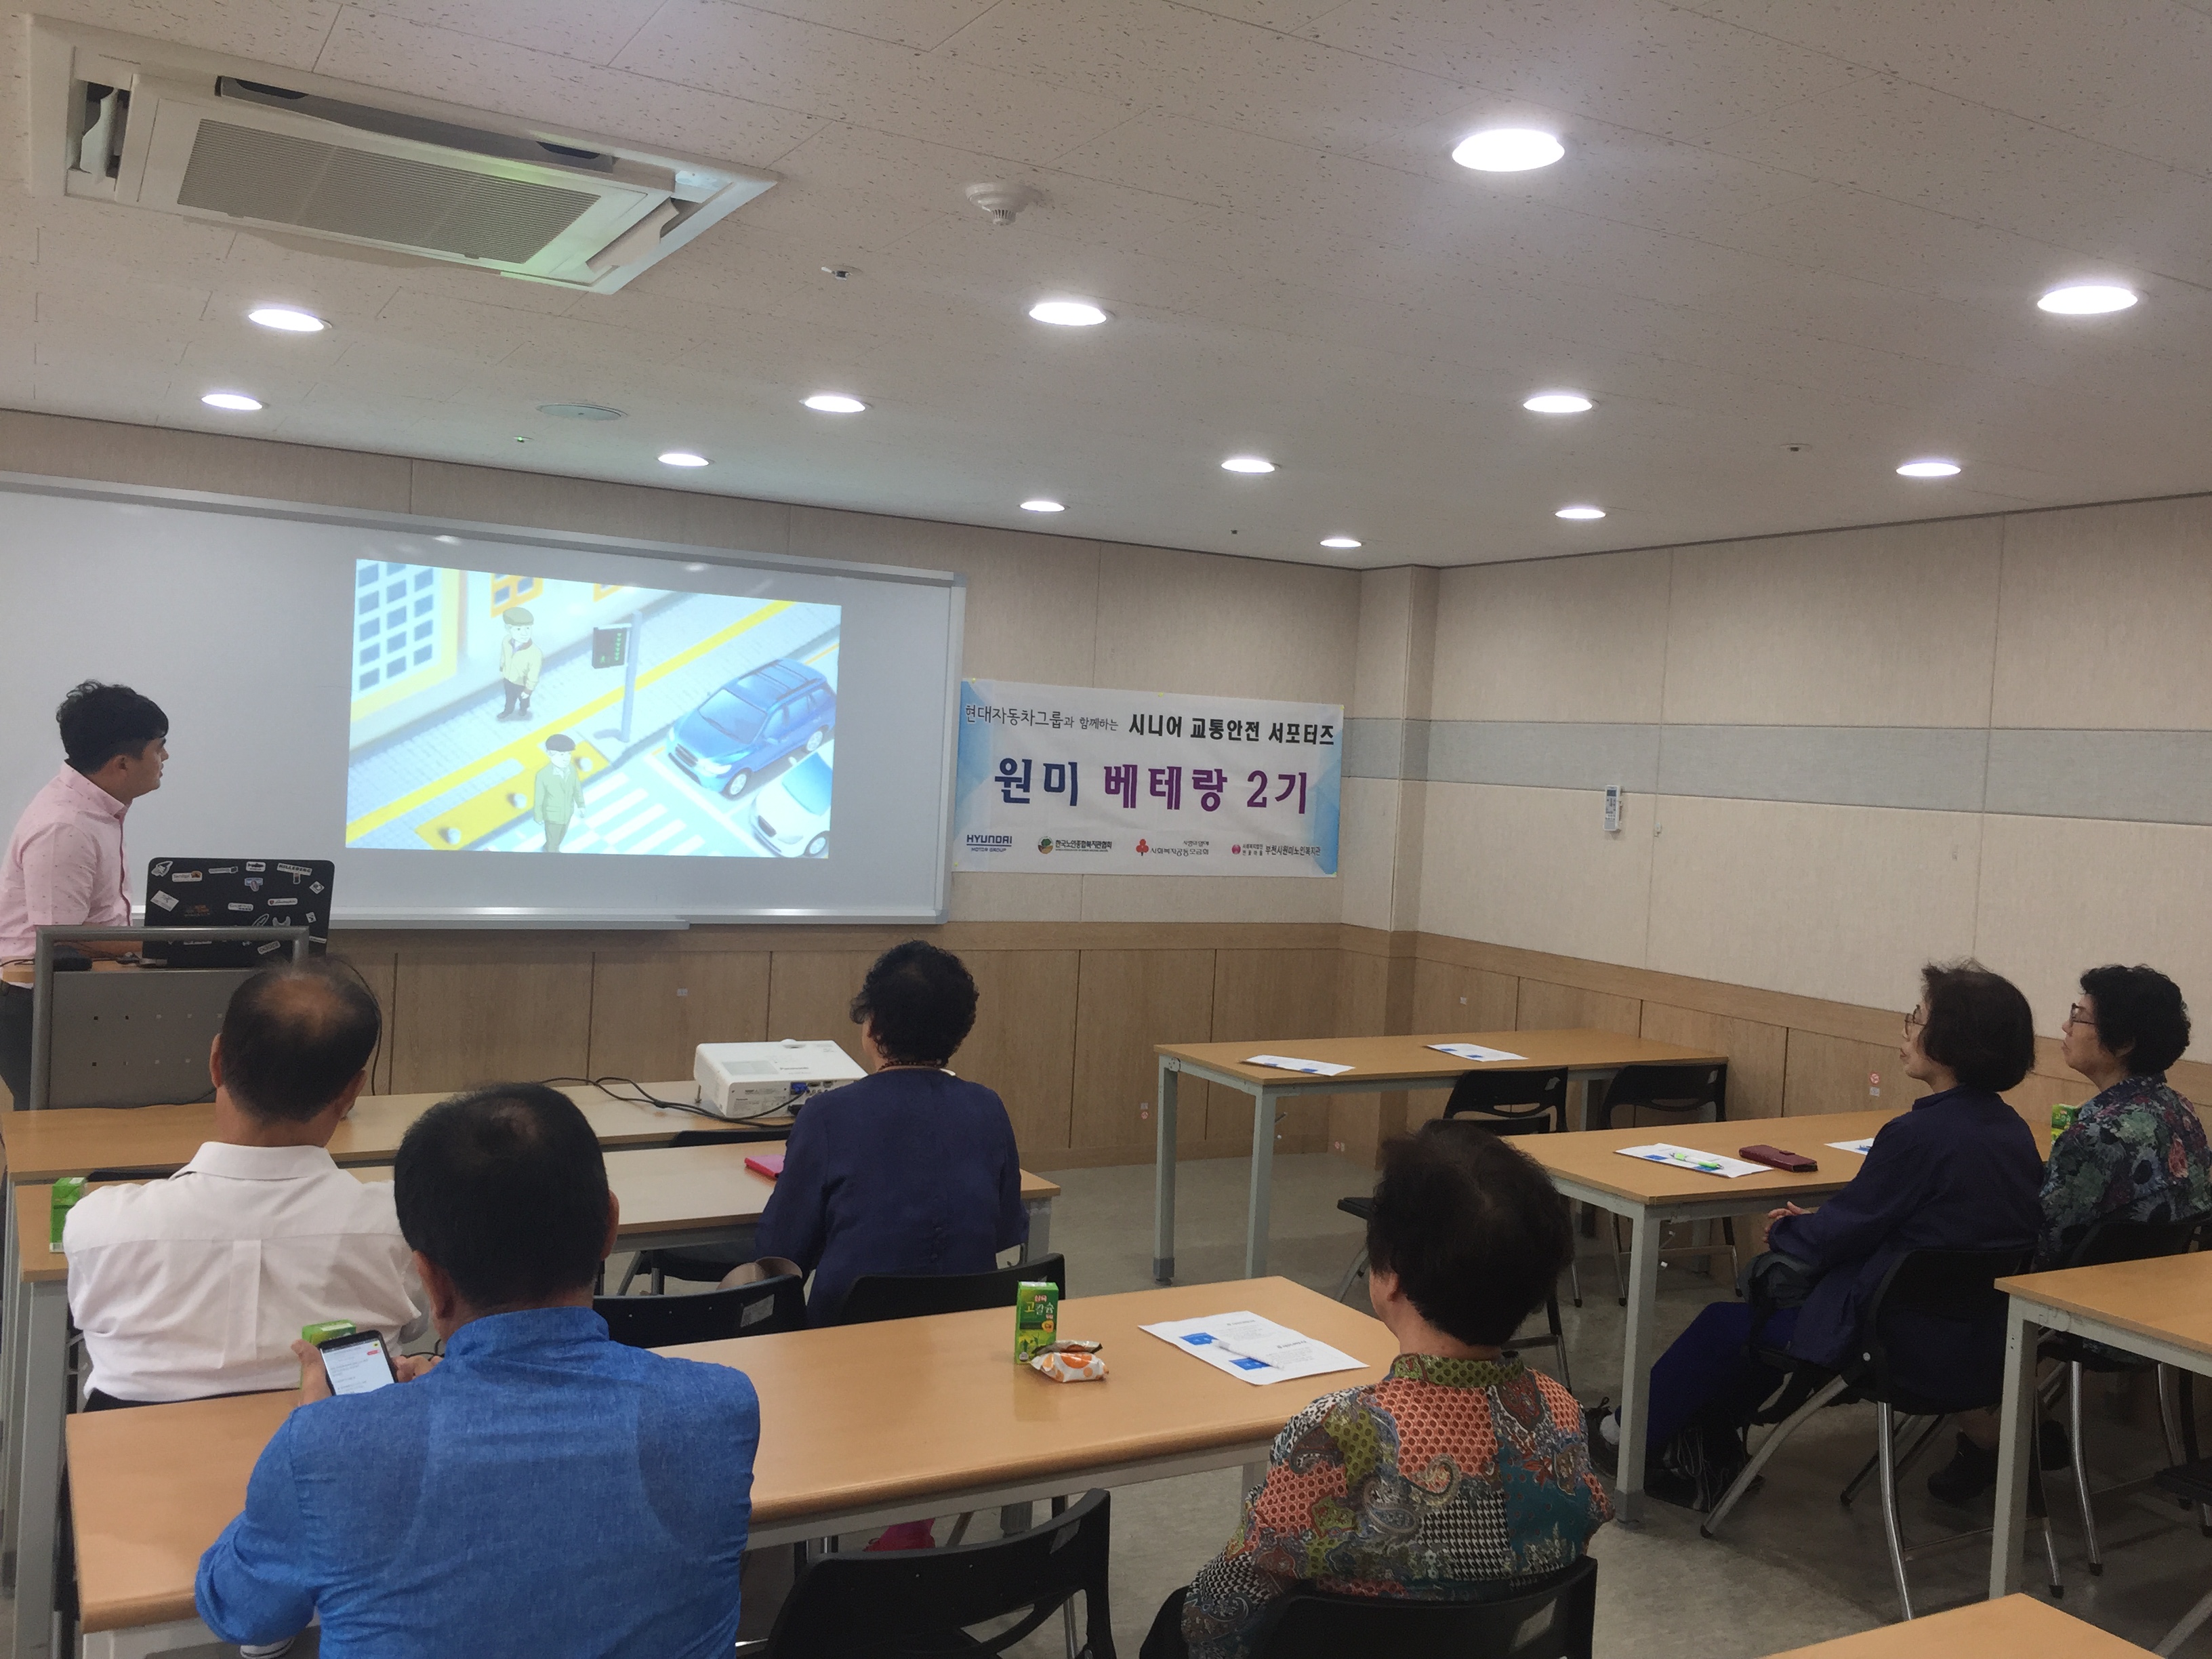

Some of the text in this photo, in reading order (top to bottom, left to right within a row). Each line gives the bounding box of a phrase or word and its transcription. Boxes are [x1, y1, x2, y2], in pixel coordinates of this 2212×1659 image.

[965, 705, 1334, 745] 현대자동차그룹과 함께하는 시니어 교통안전 서포터즈
[995, 758, 1307, 815] 원미 베테랑 2기
[966, 834, 1012, 844] HYUNDAI
[1055, 839, 1113, 850] 한국노인종합복지관협회
[1150, 847, 1210, 857] 사회복지공동모금회
[1265, 844, 1322, 857] 부천시원미노인복지관
[1024, 1302, 1054, 1315] 고칼슘
